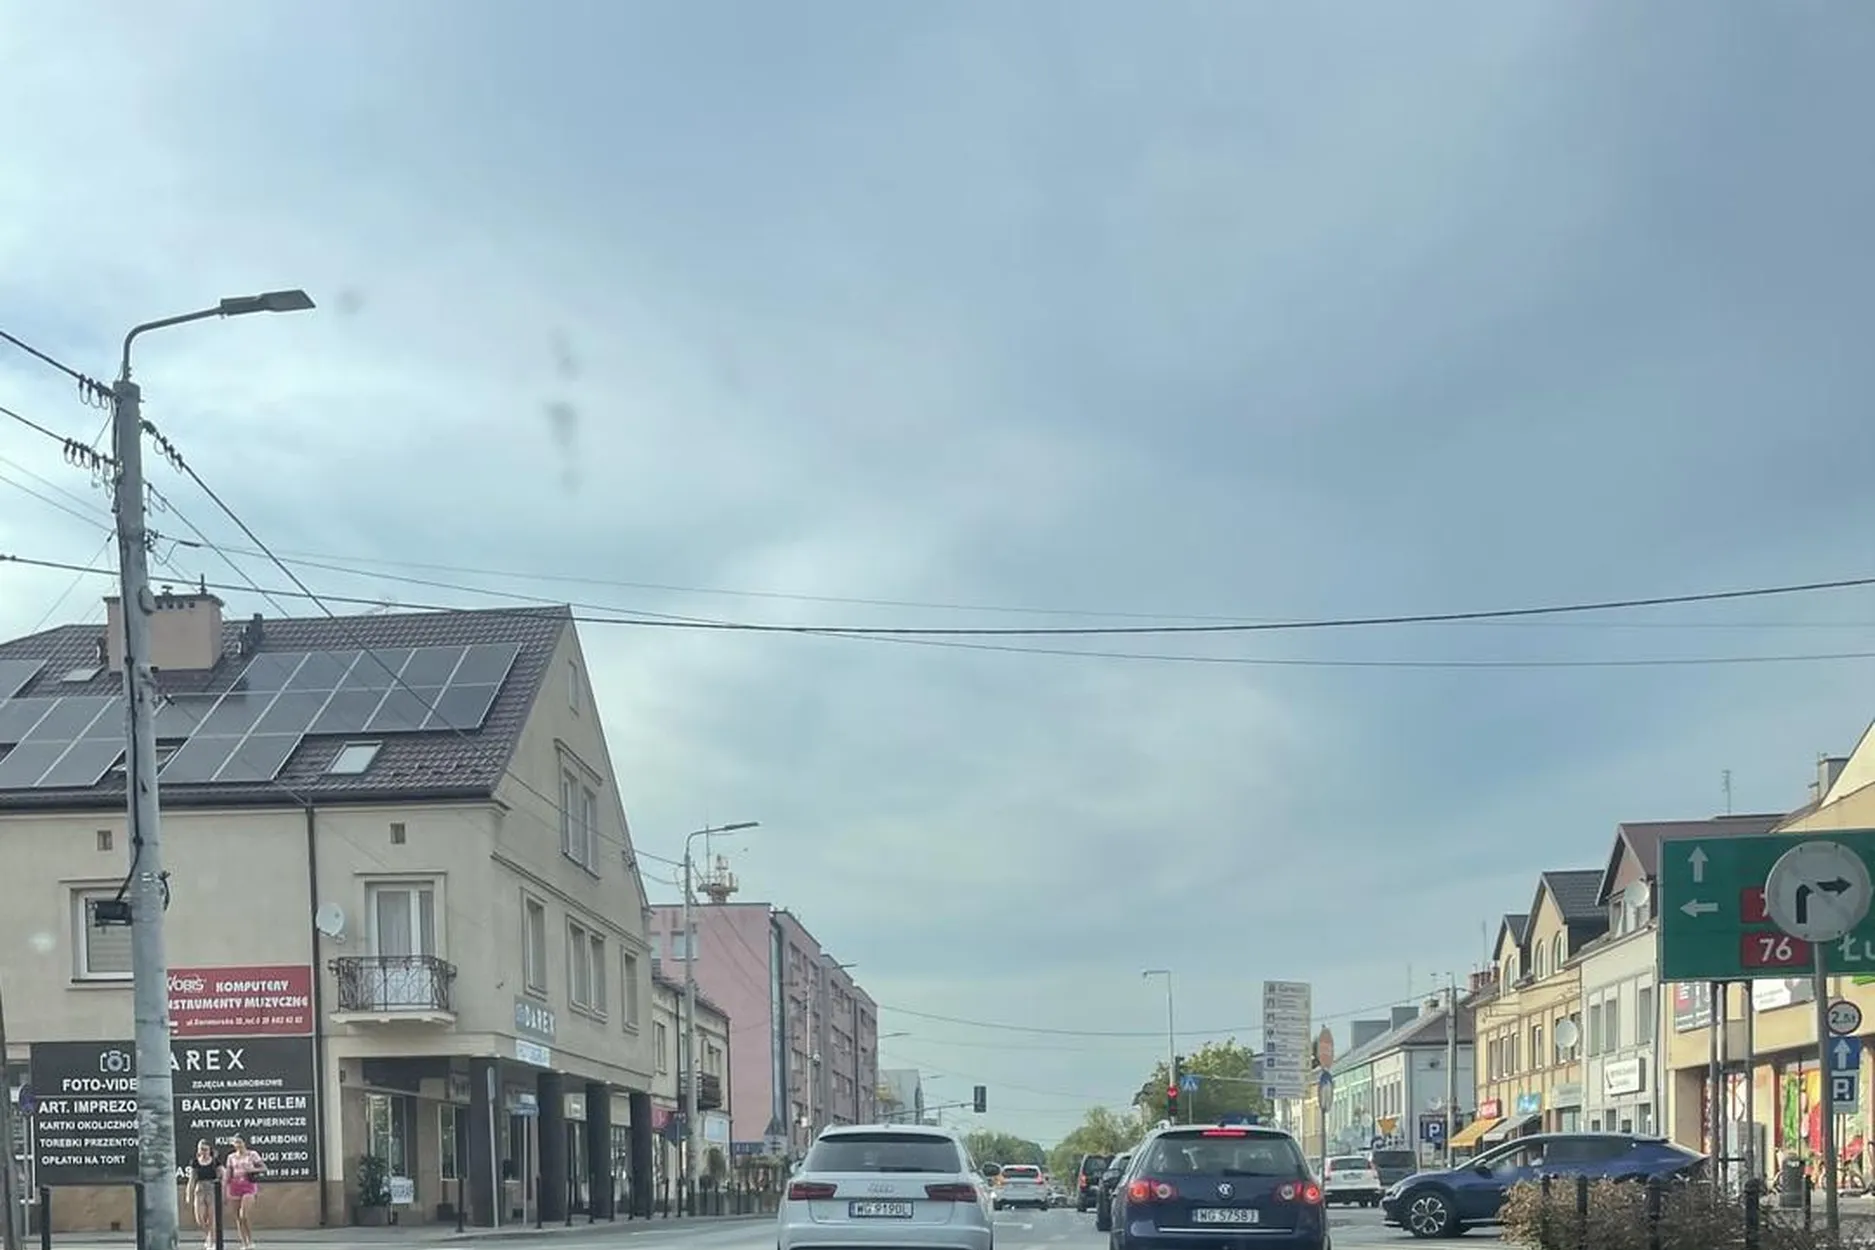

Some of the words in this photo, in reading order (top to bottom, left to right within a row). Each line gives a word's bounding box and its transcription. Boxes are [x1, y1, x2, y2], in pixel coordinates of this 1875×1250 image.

[1759, 937, 1792, 962] 76
[216, 980, 289, 993] KOMPUTERY
[244, 996, 308, 1008] MUZYCZNE
[170, 1049, 244, 1071] AREX
[63, 1079, 137, 1091] FOTO-VIDE
[39, 1101, 70, 1113] ART.
[74, 1100, 137, 1113] IMPREZO
[182, 1098, 241, 1112] BALONY
[244, 1098, 254, 1110] Z
[258, 1097, 306, 1110] HELEM
[40, 1121, 75, 1130] KARTKI
[77, 1119, 139, 1130] OKOLICZNOŚ
[244, 1117, 307, 1127] PAPIERNICZE
[1429, 1123, 1440, 1138] P
[40, 1138, 82, 1148] TOREBKI
[84, 1138, 139, 1147] PREZENTO
[250, 1134, 307, 1145] SKARBONKI
[41, 1155, 82, 1165] OPŁATKI
[84, 1155, 99, 1164] NA
[100, 1155, 125, 1164] TORT
[261, 1152, 279, 1161] UGI
[281, 1151, 308, 1161] XERO
[858, 1203, 872, 1214] WG
[1200, 1209, 1216, 1221] WG
